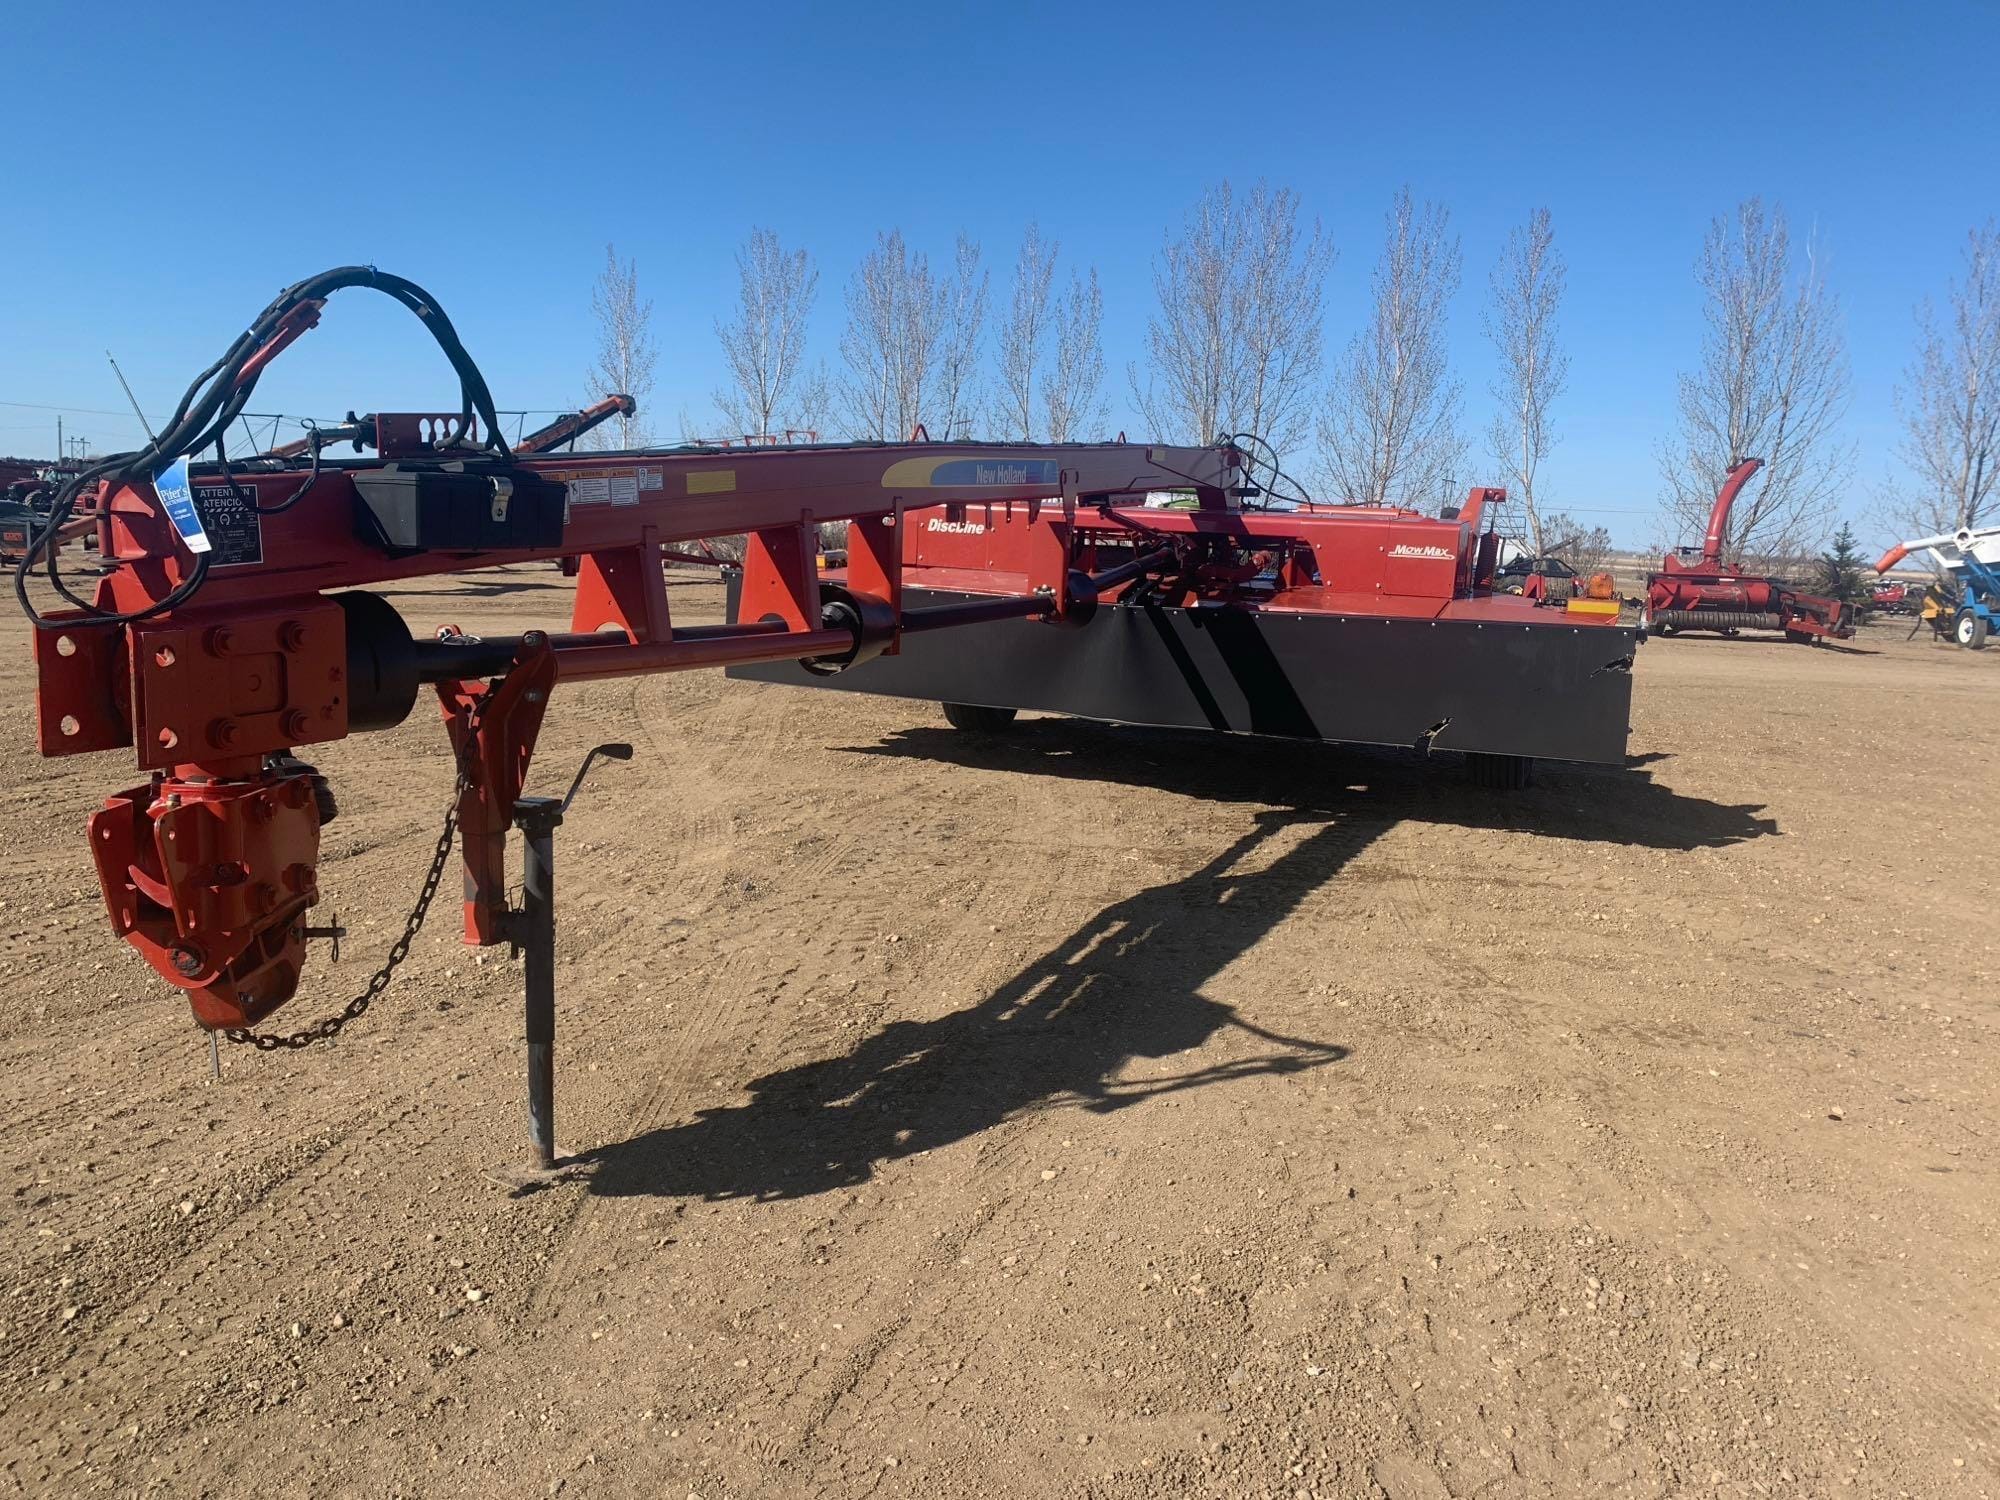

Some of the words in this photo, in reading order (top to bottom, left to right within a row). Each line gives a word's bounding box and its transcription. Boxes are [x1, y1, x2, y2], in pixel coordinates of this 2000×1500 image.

[976, 464, 995, 484] New
[997, 464, 1027, 484] Holland
[160, 485, 188, 501] Pifer's
[199, 488, 250, 498] ATTENTN
